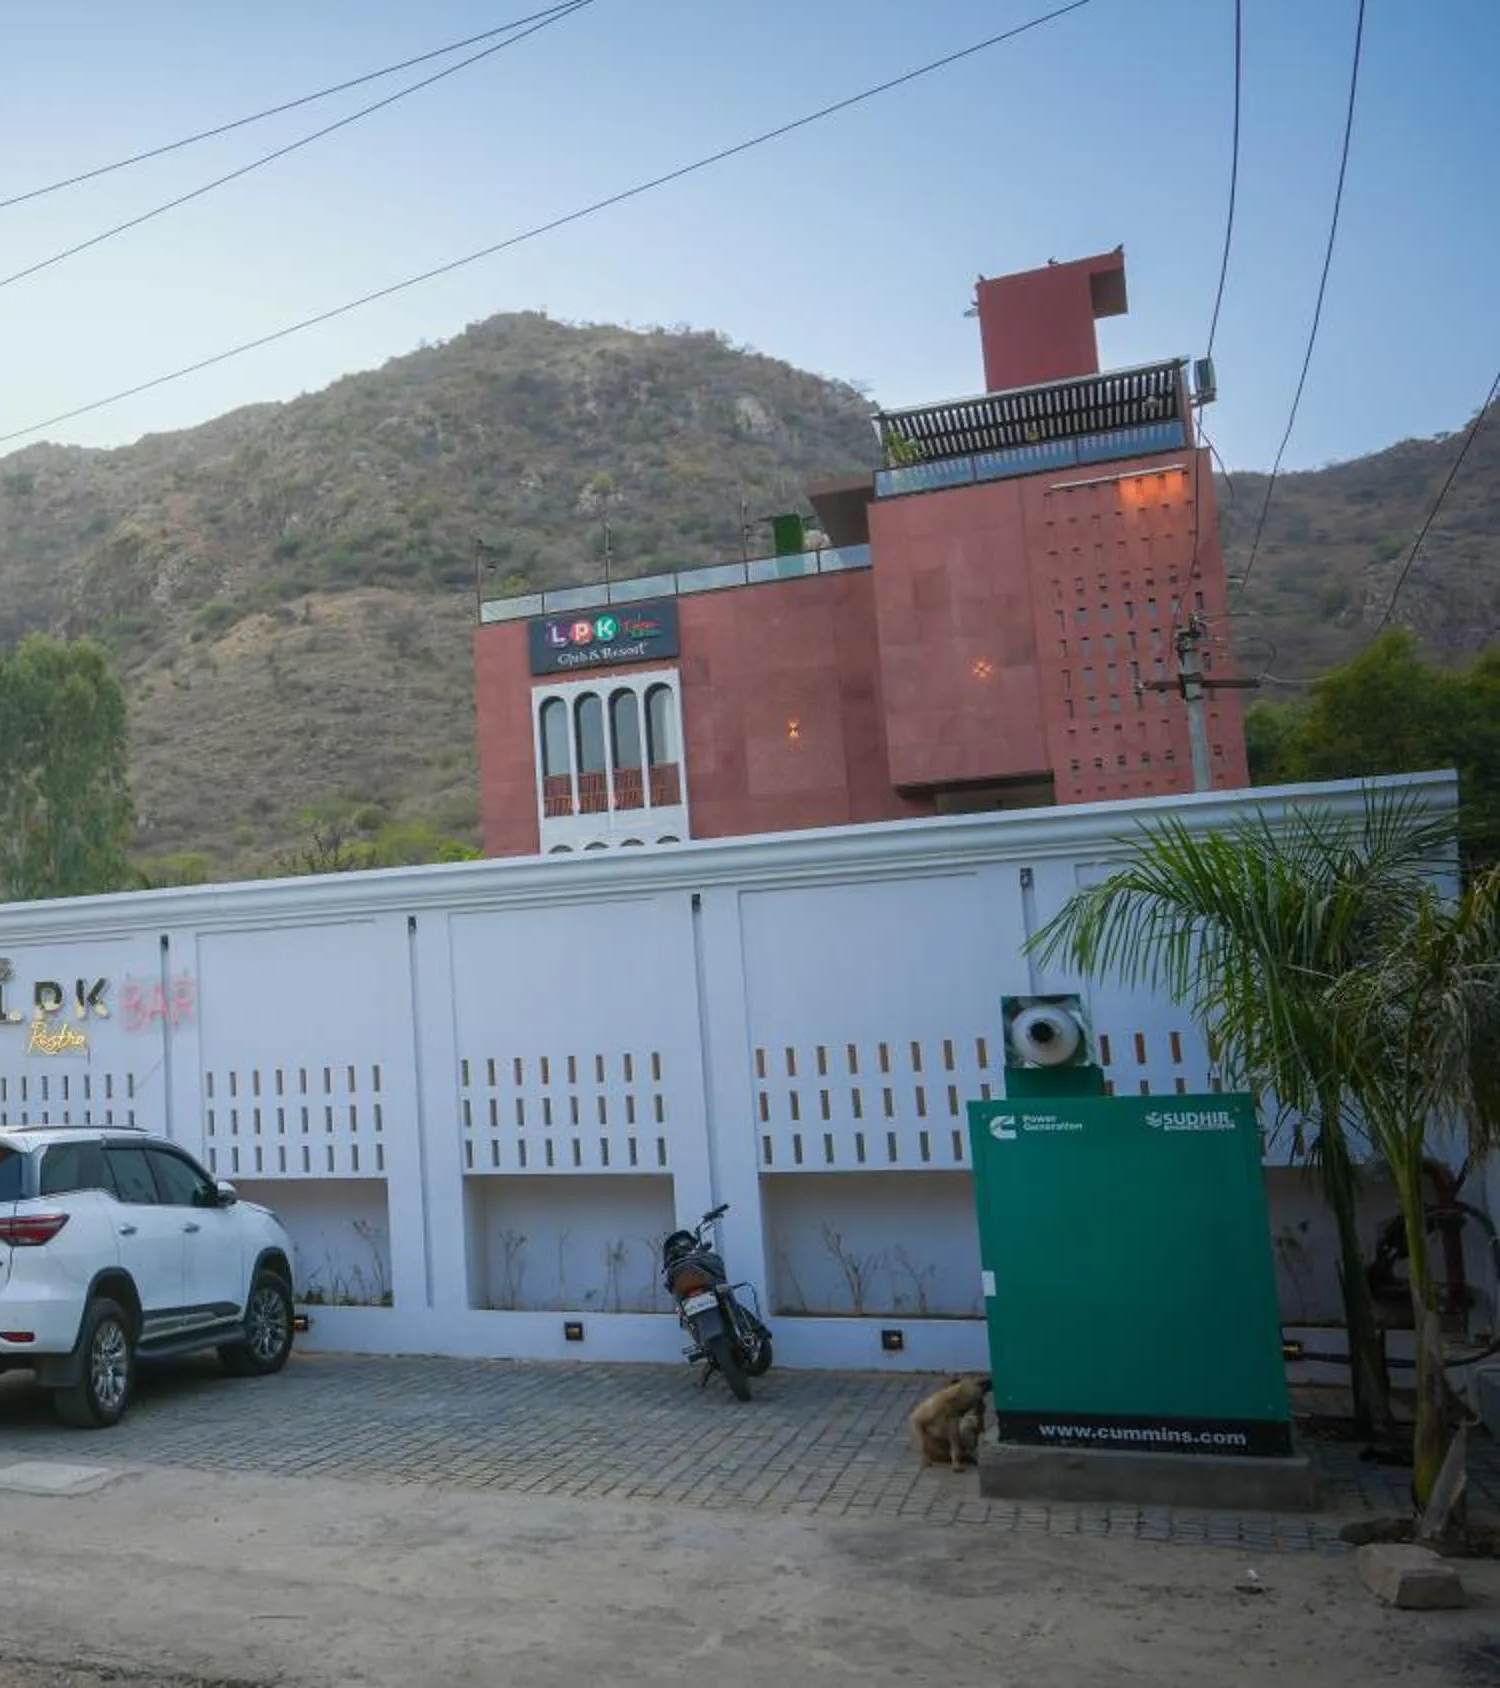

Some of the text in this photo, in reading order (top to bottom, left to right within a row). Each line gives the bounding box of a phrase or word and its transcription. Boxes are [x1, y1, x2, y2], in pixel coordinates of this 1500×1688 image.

[551, 617, 614, 643] LPK
[117, 974, 197, 1031] BAR
[1023, 1115, 1057, 1123] Power
[1023, 1123, 1083, 1132] Generation
[1163, 1112, 1230, 1127] SUDHIR
[1038, 1424, 1247, 1445] www.cummins.com
